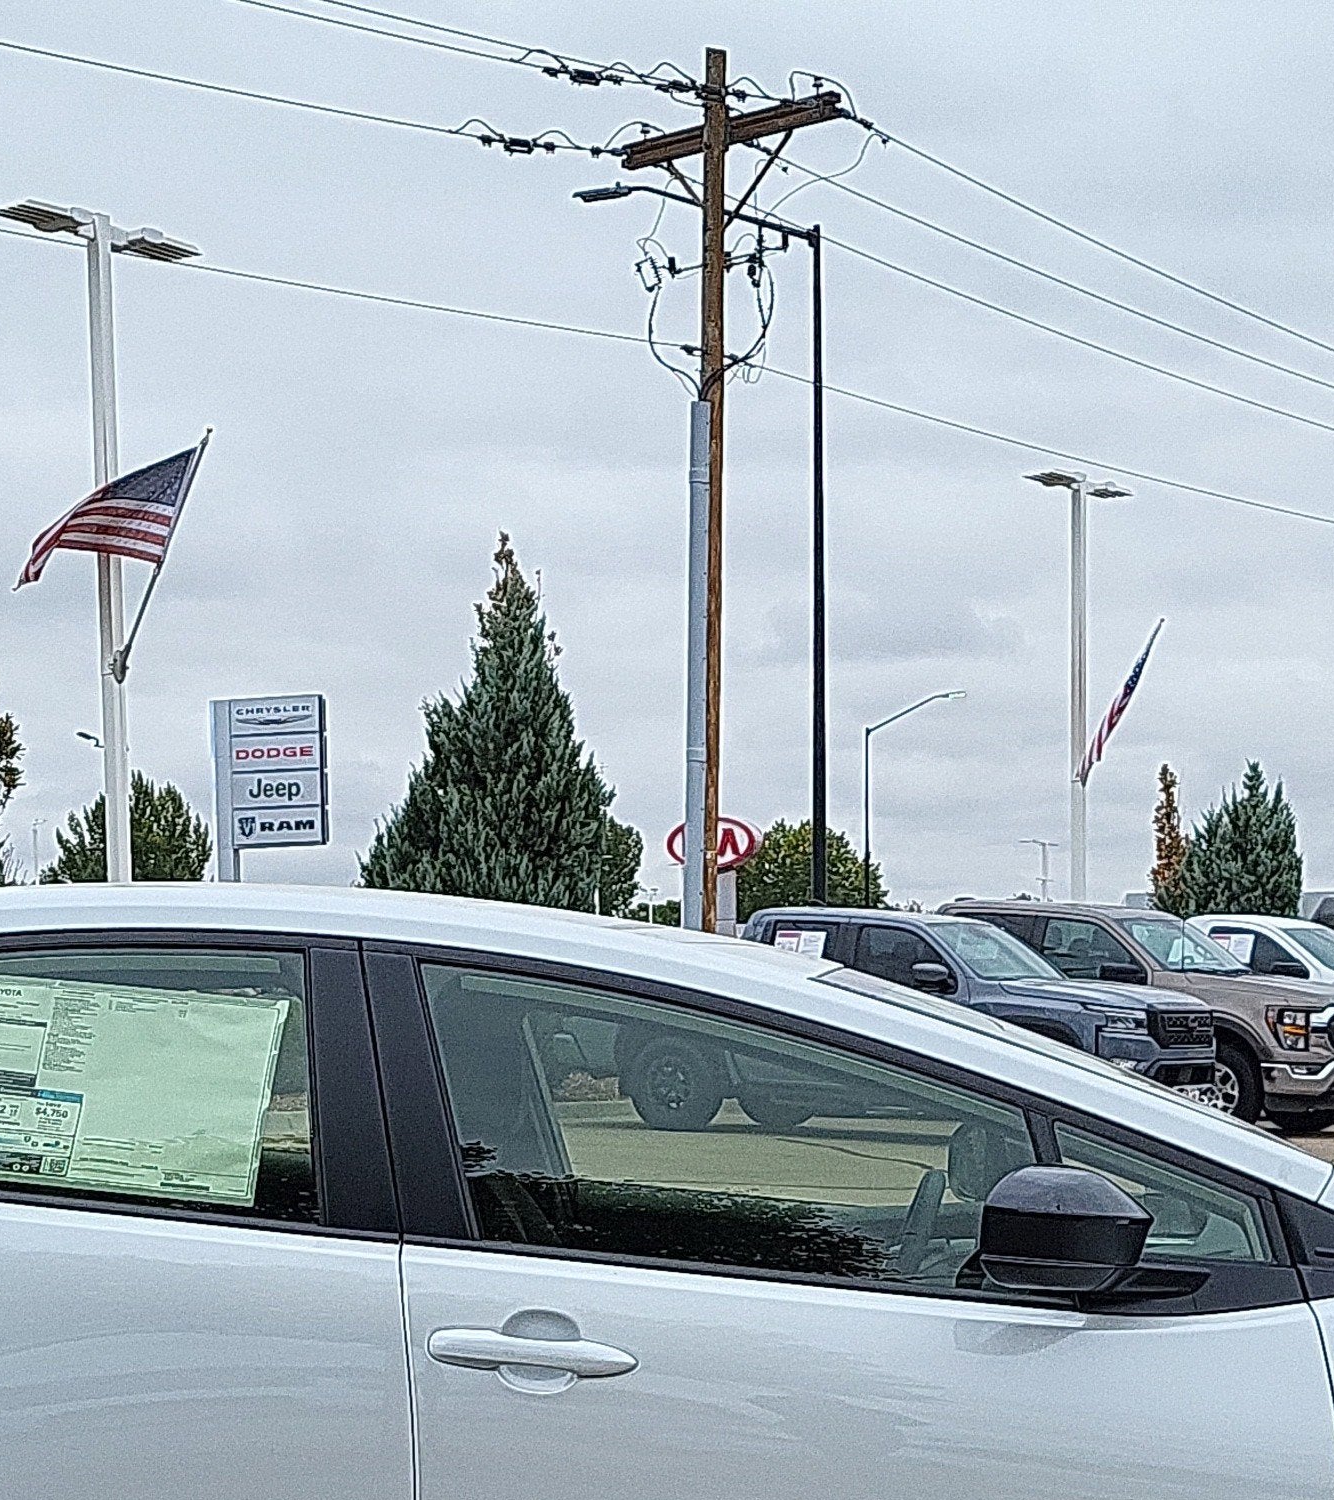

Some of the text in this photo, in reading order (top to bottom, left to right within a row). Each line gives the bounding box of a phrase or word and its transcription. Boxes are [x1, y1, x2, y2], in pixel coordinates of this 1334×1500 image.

[235, 705, 311, 715] CHRYSLER
[235, 745, 314, 760] DODGE
[248, 778, 302, 801] Jeep
[259, 819, 315, 832] RAM
